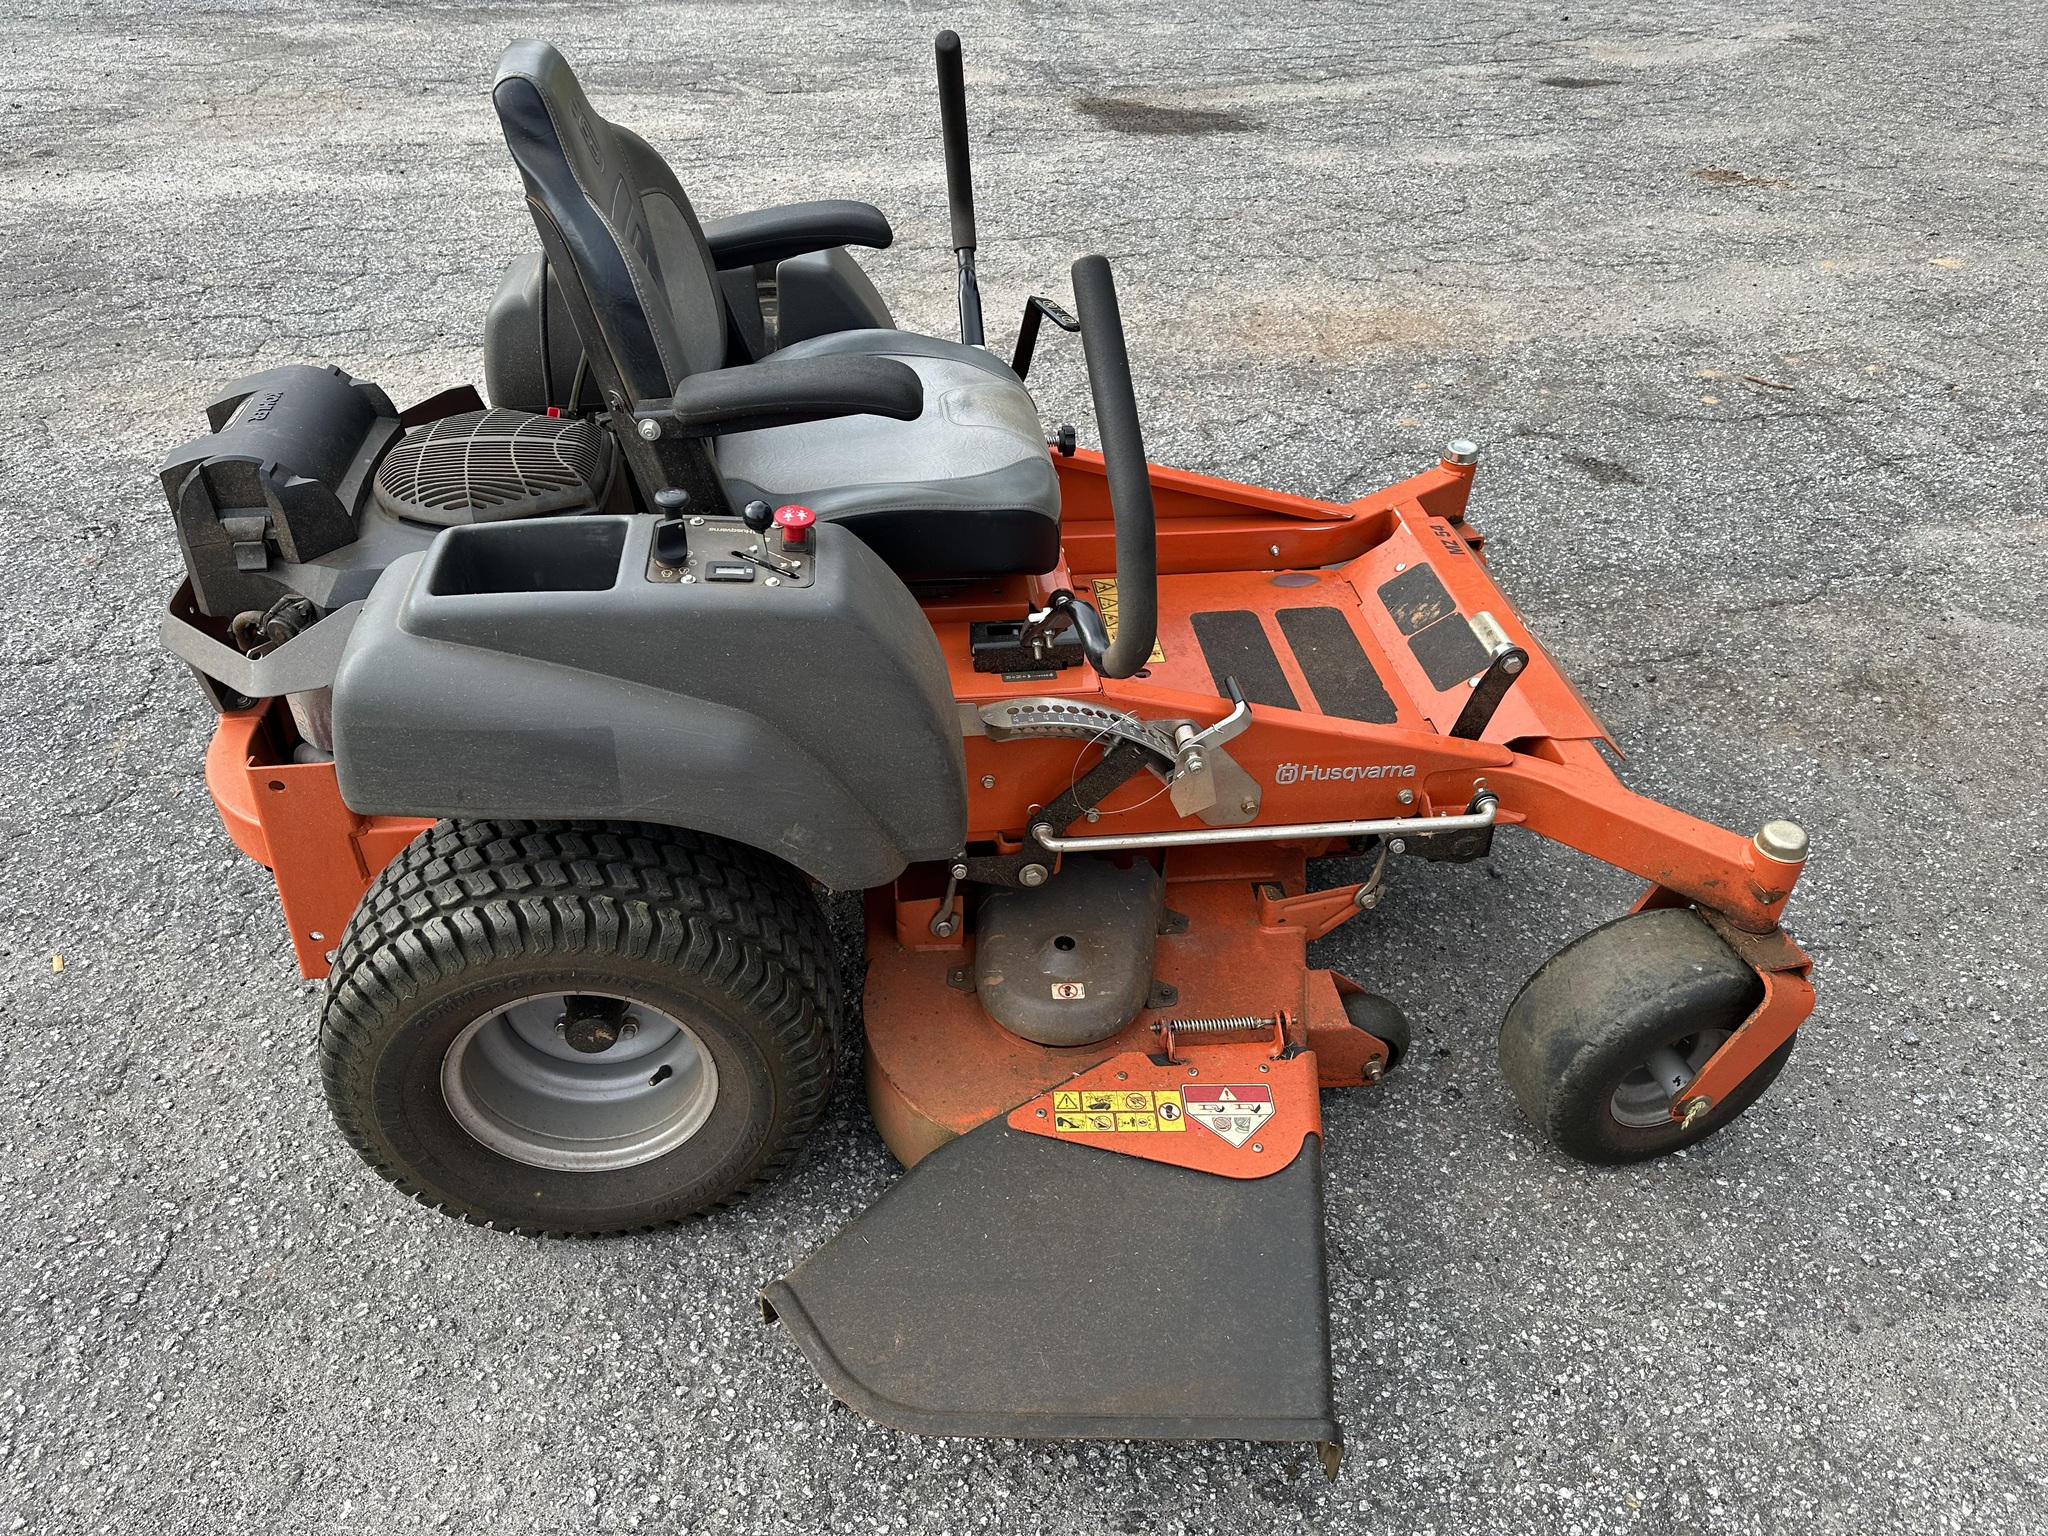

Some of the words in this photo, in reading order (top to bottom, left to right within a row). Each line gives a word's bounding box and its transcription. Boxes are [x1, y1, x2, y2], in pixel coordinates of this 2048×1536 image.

[247, 393, 284, 423] KOHLER
[1430, 525, 1451, 537] 54
[1441, 540, 1465, 554] MZ
[1301, 764, 1415, 781] Husqvarna
[416, 974, 570, 1030] COMMERCIAL
[583, 973, 655, 992] TURF
